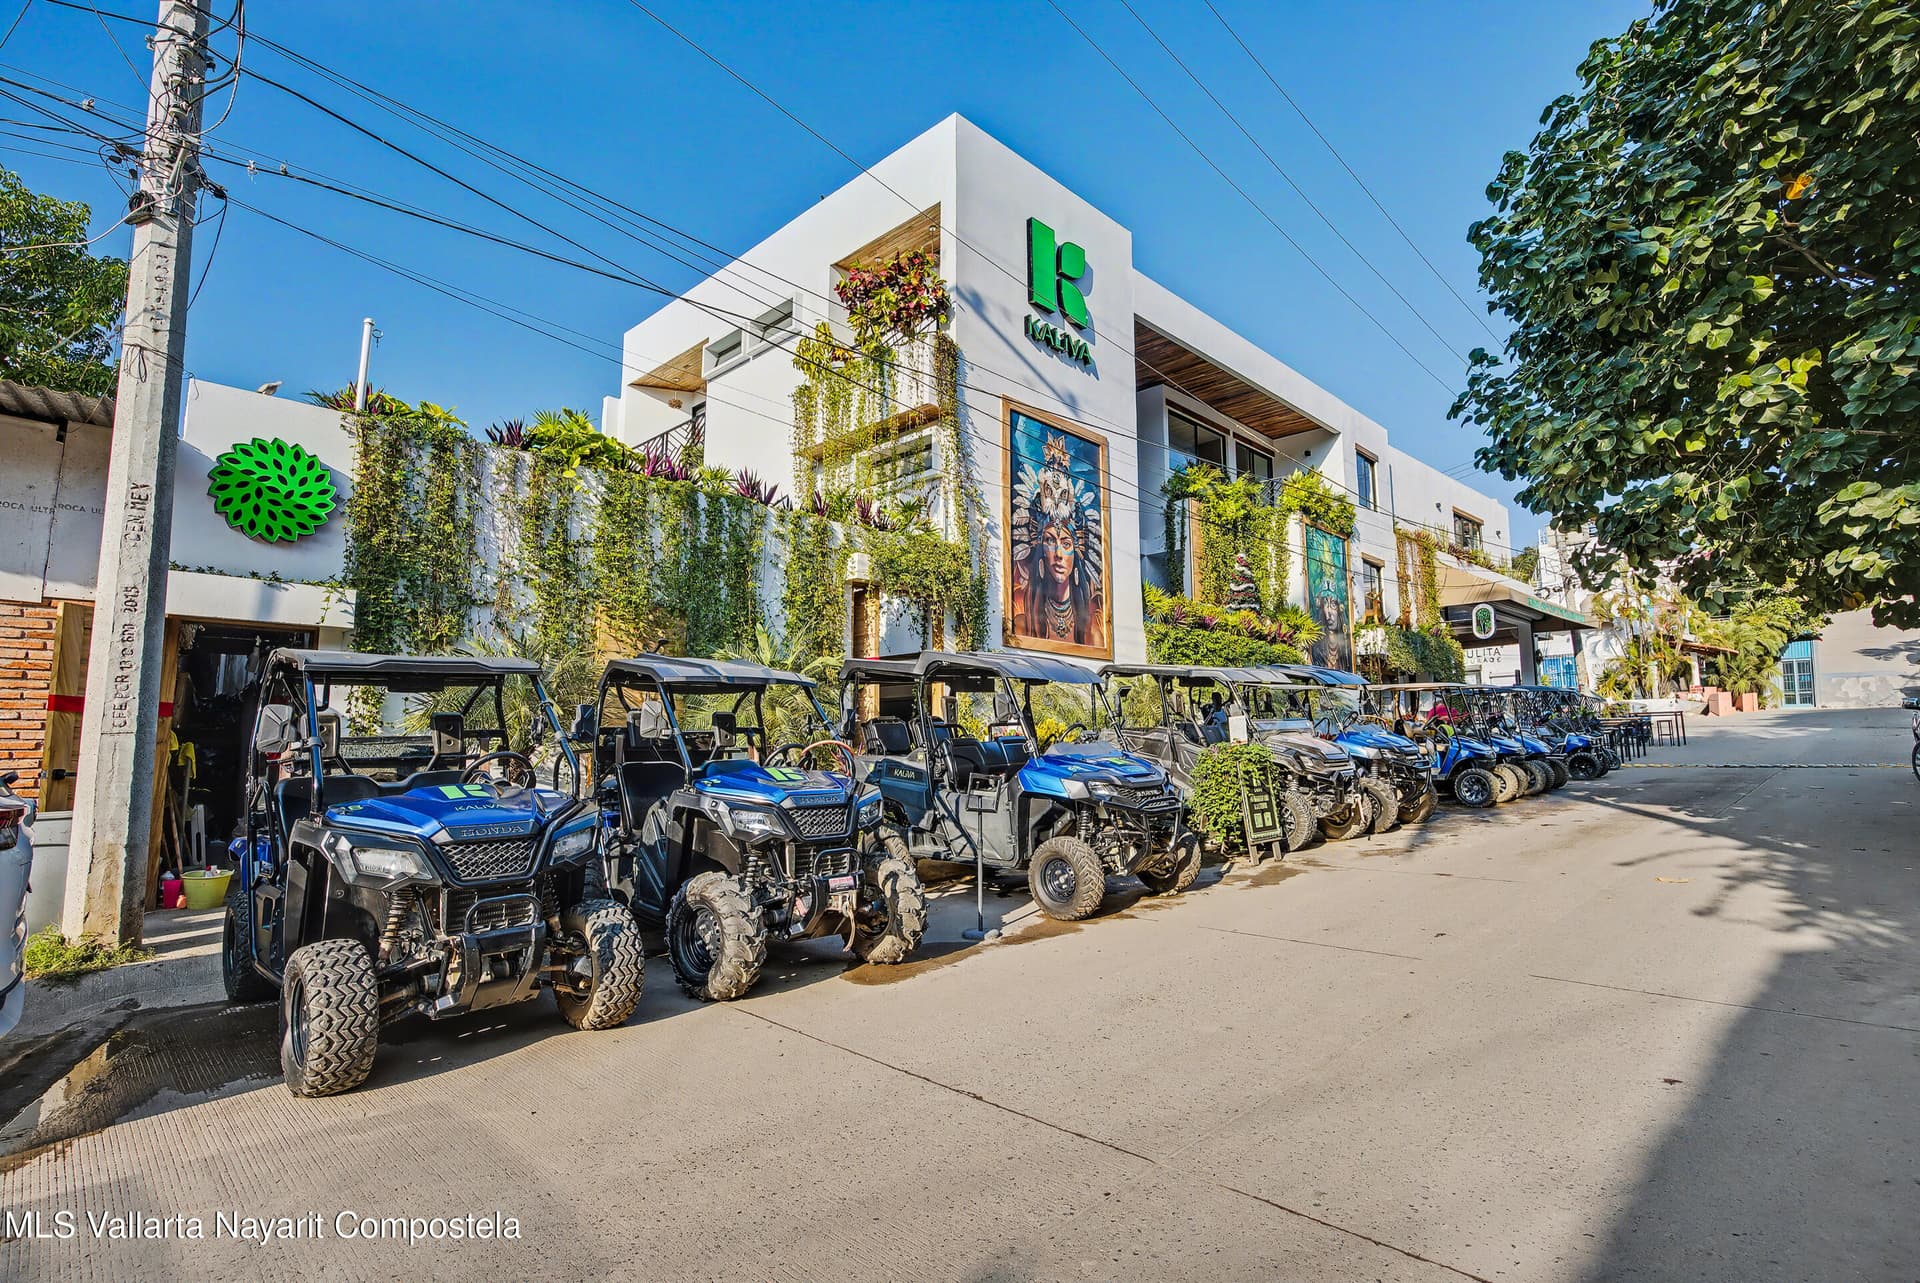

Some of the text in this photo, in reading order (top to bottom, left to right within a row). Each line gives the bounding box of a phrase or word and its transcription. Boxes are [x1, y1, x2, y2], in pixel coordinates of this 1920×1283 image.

[1024, 314, 1092, 367] KALIVA
[112, 701, 128, 728] CFE
[893, 768, 916, 780] KALIVA
[460, 824, 525, 838] HONDA
